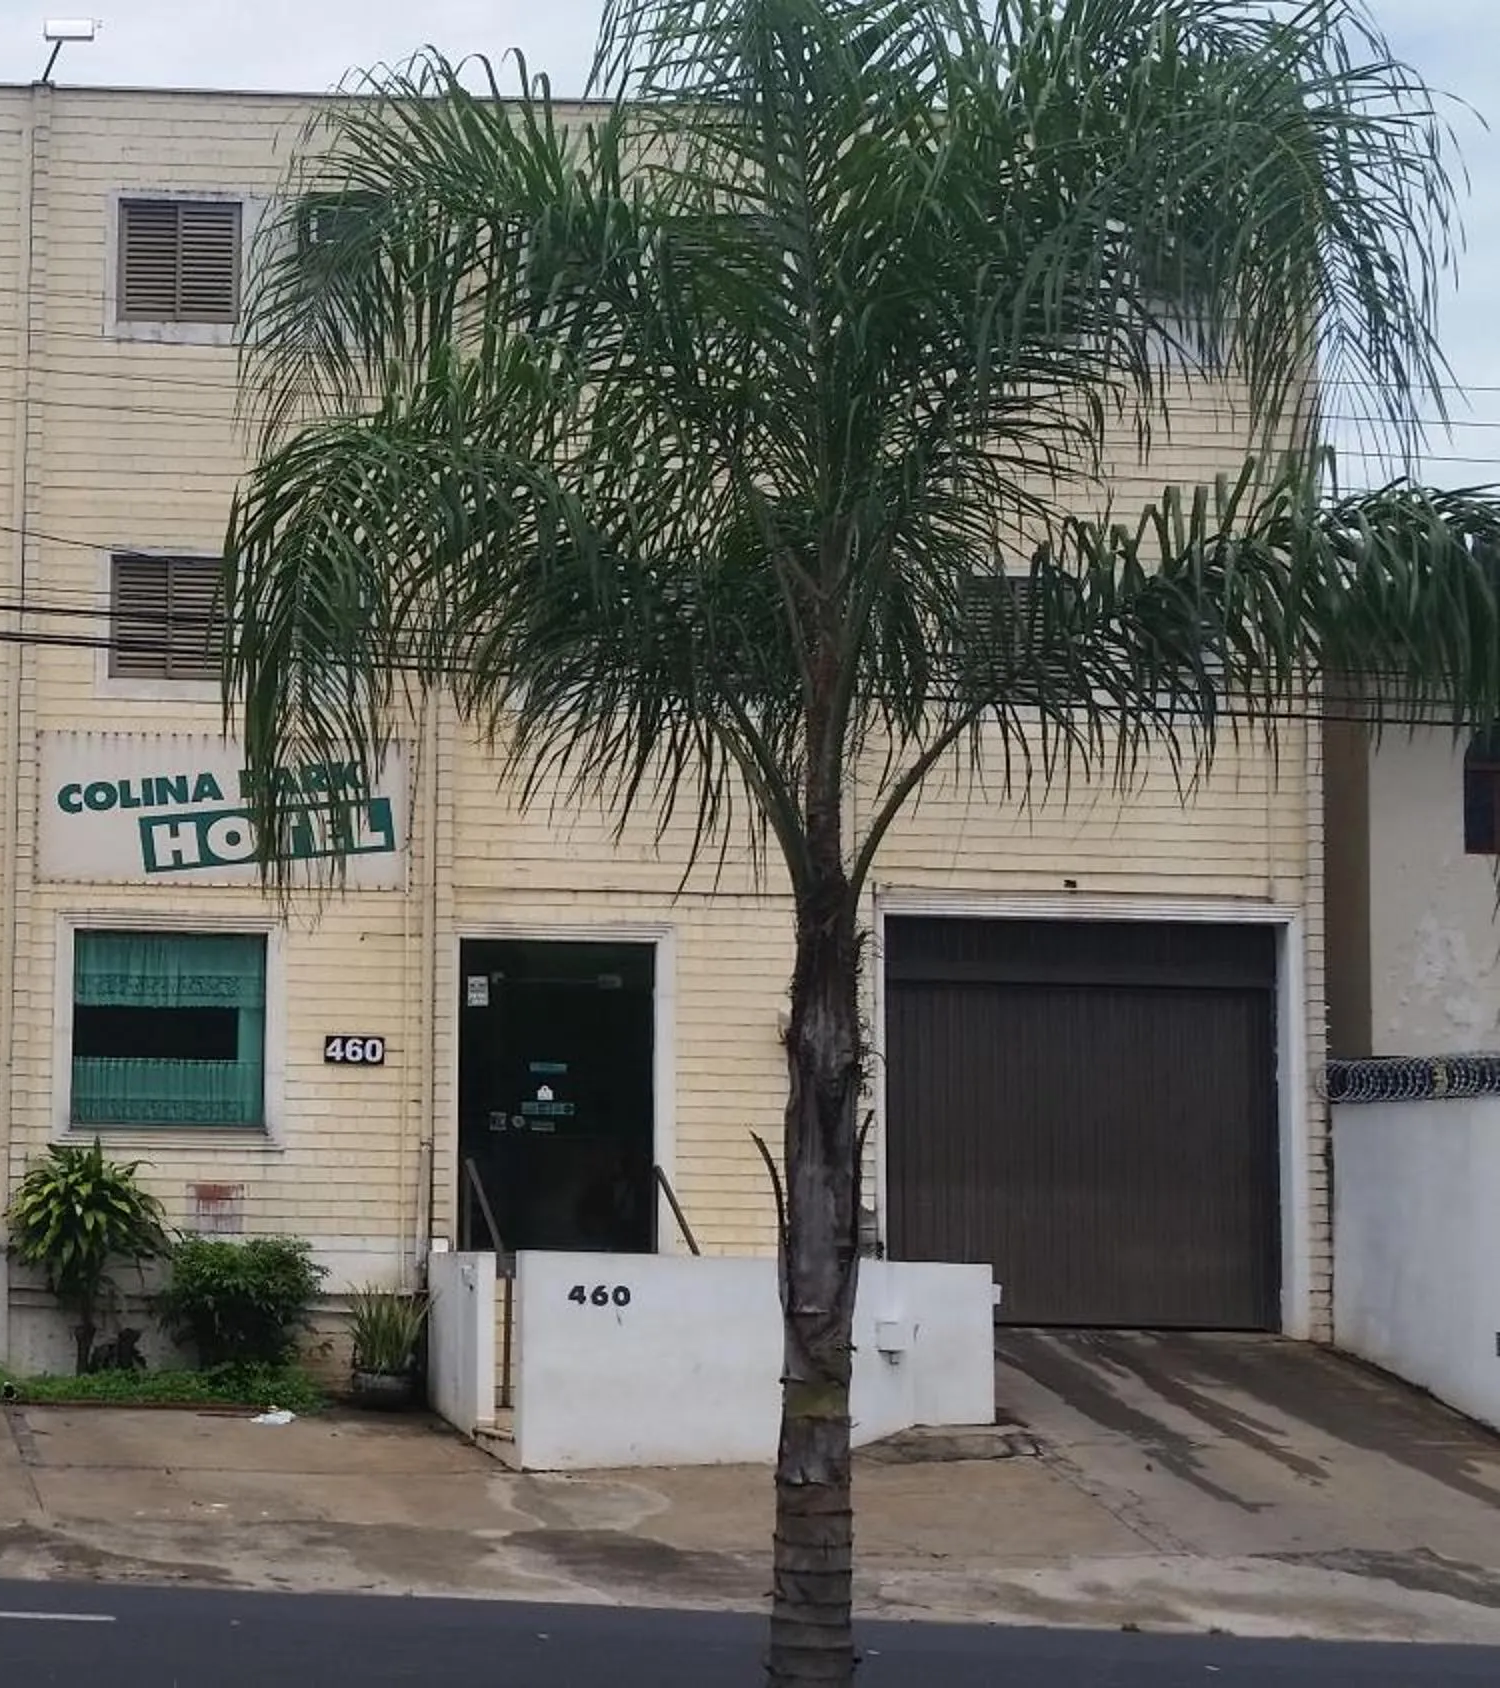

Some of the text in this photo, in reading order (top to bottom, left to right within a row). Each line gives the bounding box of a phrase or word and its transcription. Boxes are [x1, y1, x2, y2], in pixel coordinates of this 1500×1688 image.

[57, 772, 224, 813] COLINA
[152, 804, 386, 867] HOTEL
[326, 1037, 383, 1062] 460
[568, 1285, 631, 1307] 460
